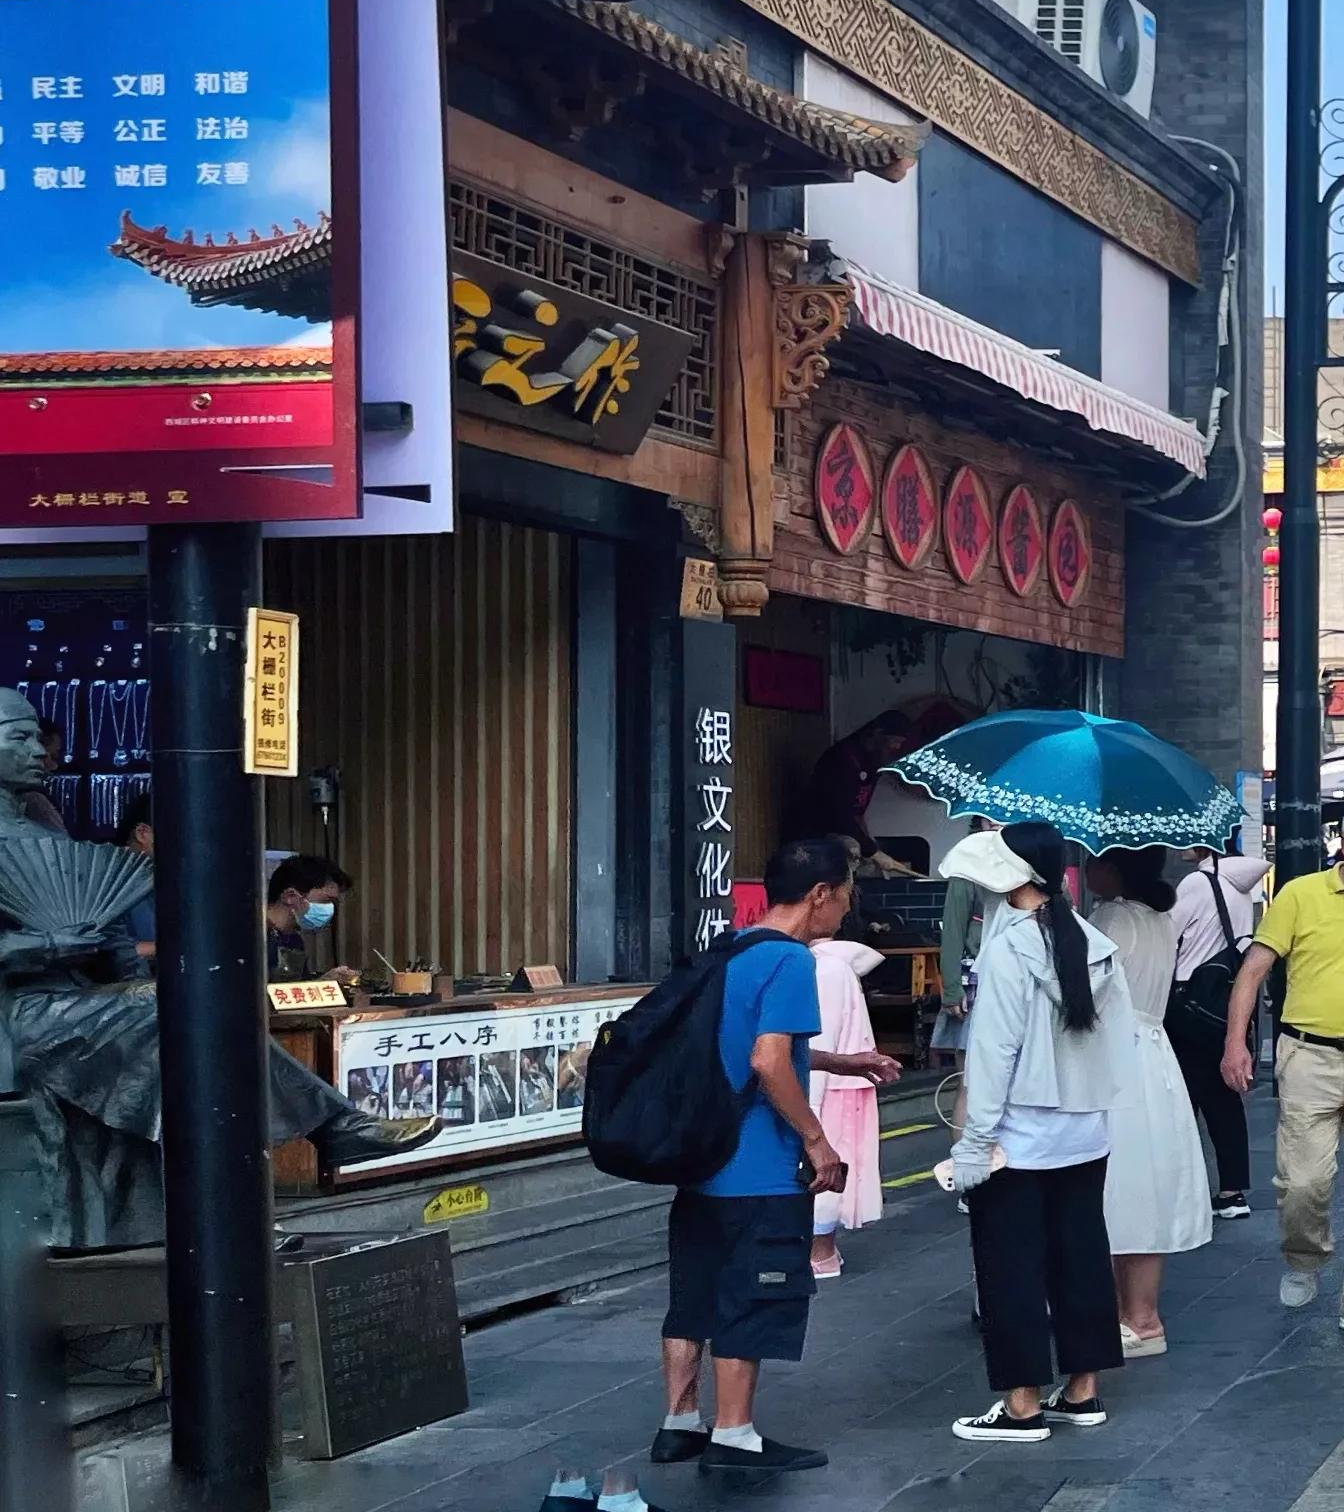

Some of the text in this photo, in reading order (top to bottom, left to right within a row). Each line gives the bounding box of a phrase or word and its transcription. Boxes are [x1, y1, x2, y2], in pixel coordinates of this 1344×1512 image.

[32, 76, 84, 99] 民主
[112, 73, 166, 97] 文明
[194, 71, 249, 95] 和谐
[32, 116, 249, 144] 平等 公正 法治
[33, 162, 249, 190] 敬业 诚信 友善
[29, 491, 150, 508] 大栅栏街道
[696, 586, 712, 611] 40
[261, 631, 277, 728] 大栅栏街
[274, 985, 339, 1005] 免费刻字
[374, 1024, 498, 1058] 手工八序
